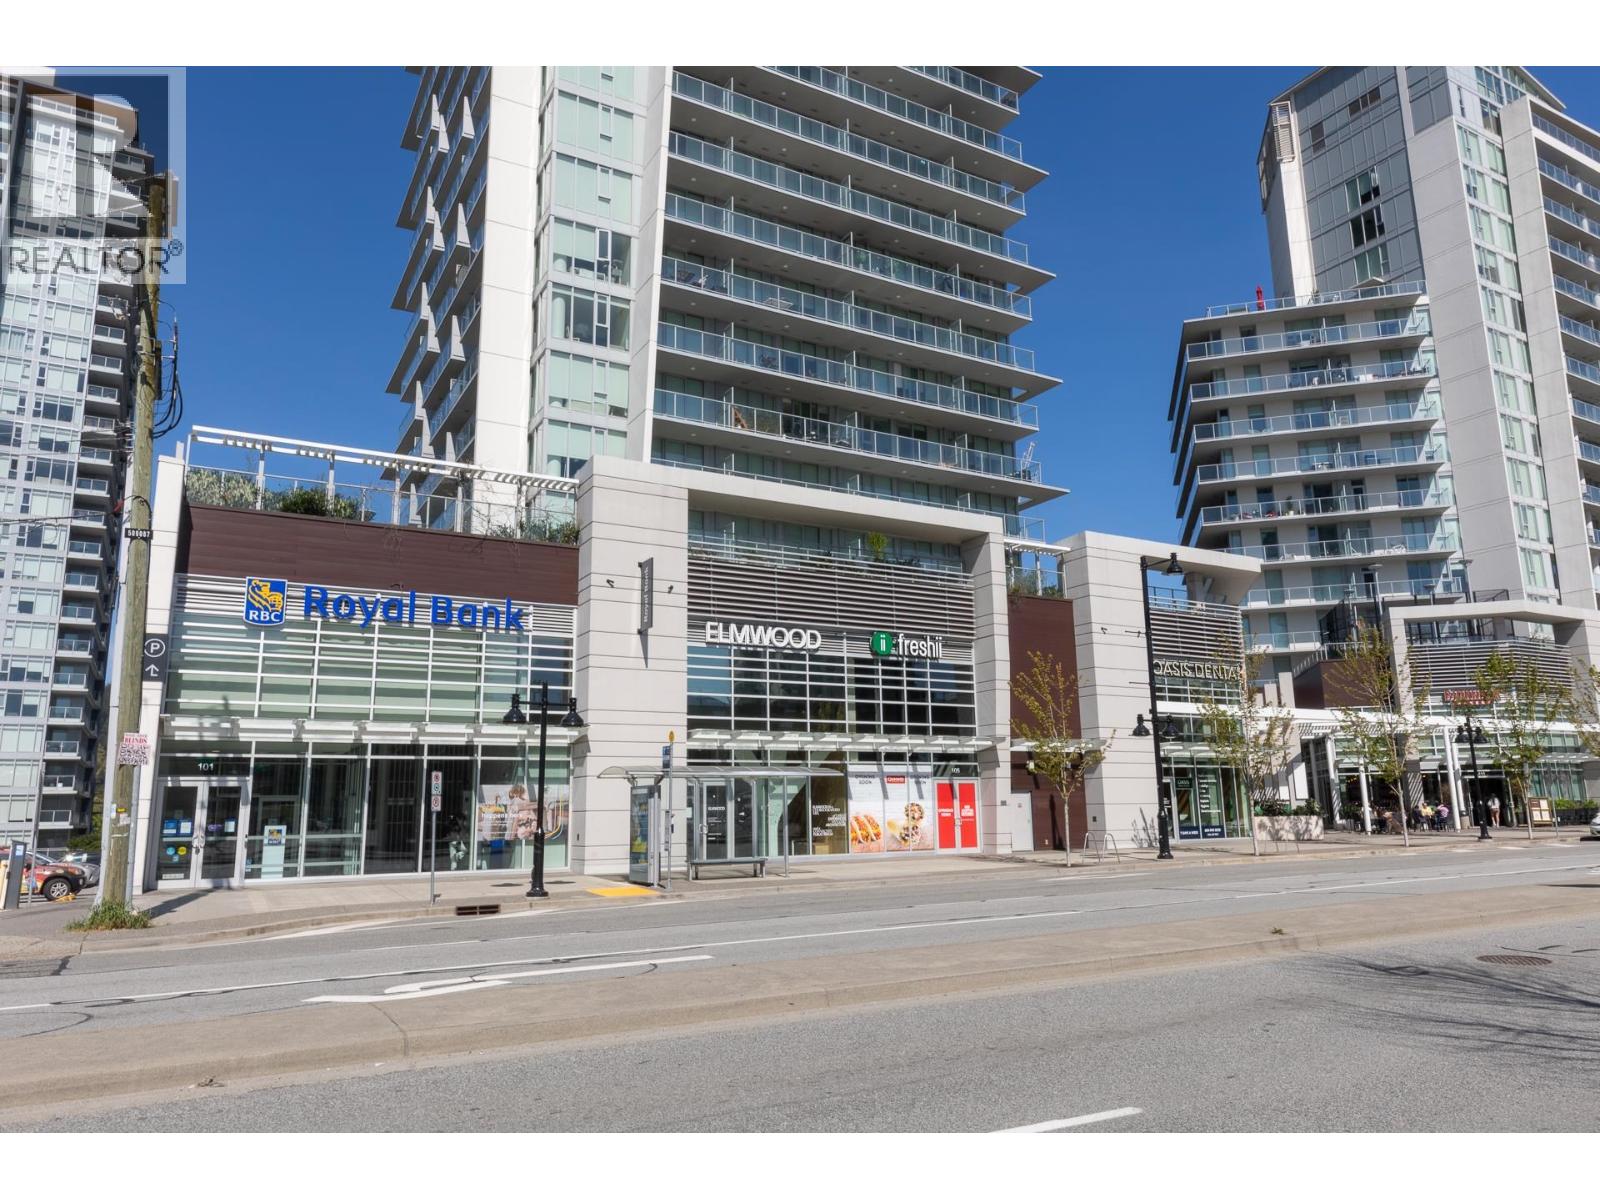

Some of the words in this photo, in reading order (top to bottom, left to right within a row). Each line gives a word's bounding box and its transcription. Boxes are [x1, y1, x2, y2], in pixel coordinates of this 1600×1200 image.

[249, 610, 280, 622] RBC
[304, 585, 417, 628] Royal
[430, 595, 525, 630] Bank
[705, 621, 822, 650] ELMWOOD
[150, 642, 160, 653] P
[898, 633, 943, 658] freshii
[1153, 660, 1191, 678] OASIS
[197, 762, 214, 771] 101
